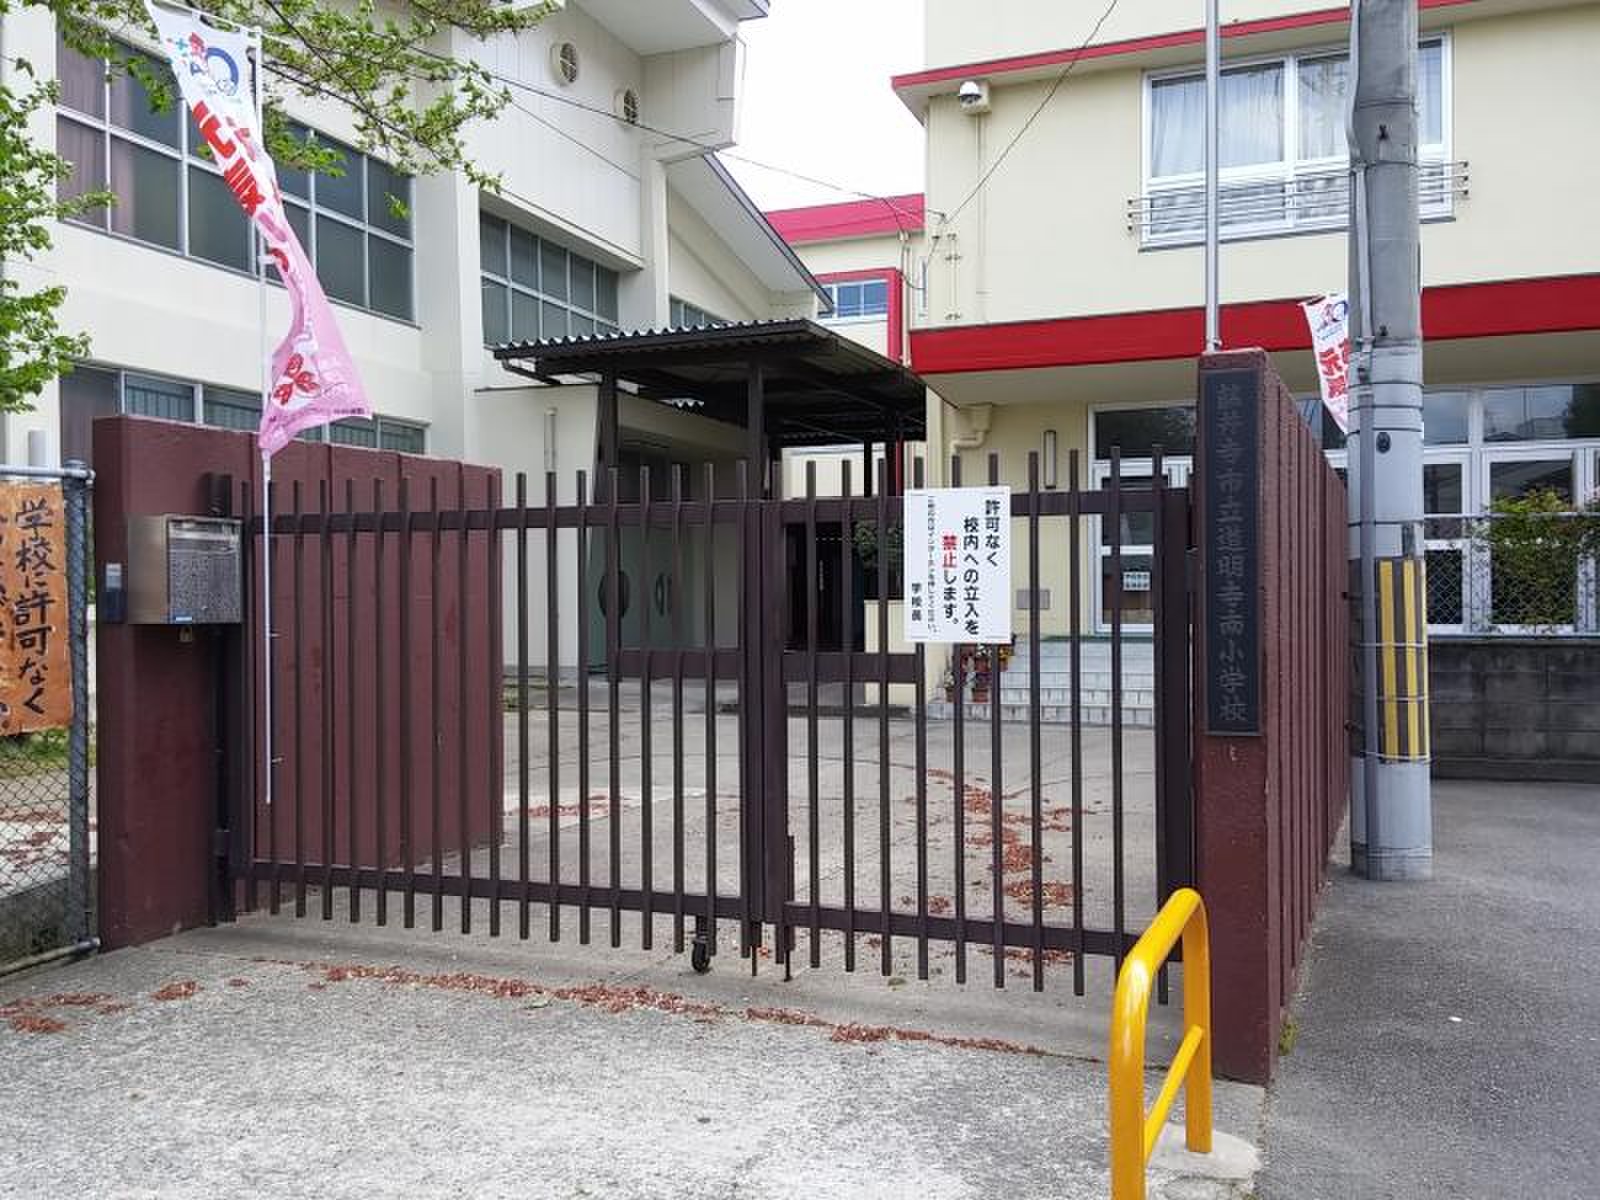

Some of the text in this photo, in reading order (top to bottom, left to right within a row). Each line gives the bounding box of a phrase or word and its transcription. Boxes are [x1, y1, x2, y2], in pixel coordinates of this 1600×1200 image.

[963, 516, 980, 636] 校内への立入を
[985, 500, 1001, 567] 許可なく
[15, 498, 55, 714] 学校に許可なく
[911, 582, 923, 622] 学校長
[942, 535, 959, 625] 禁止します。
